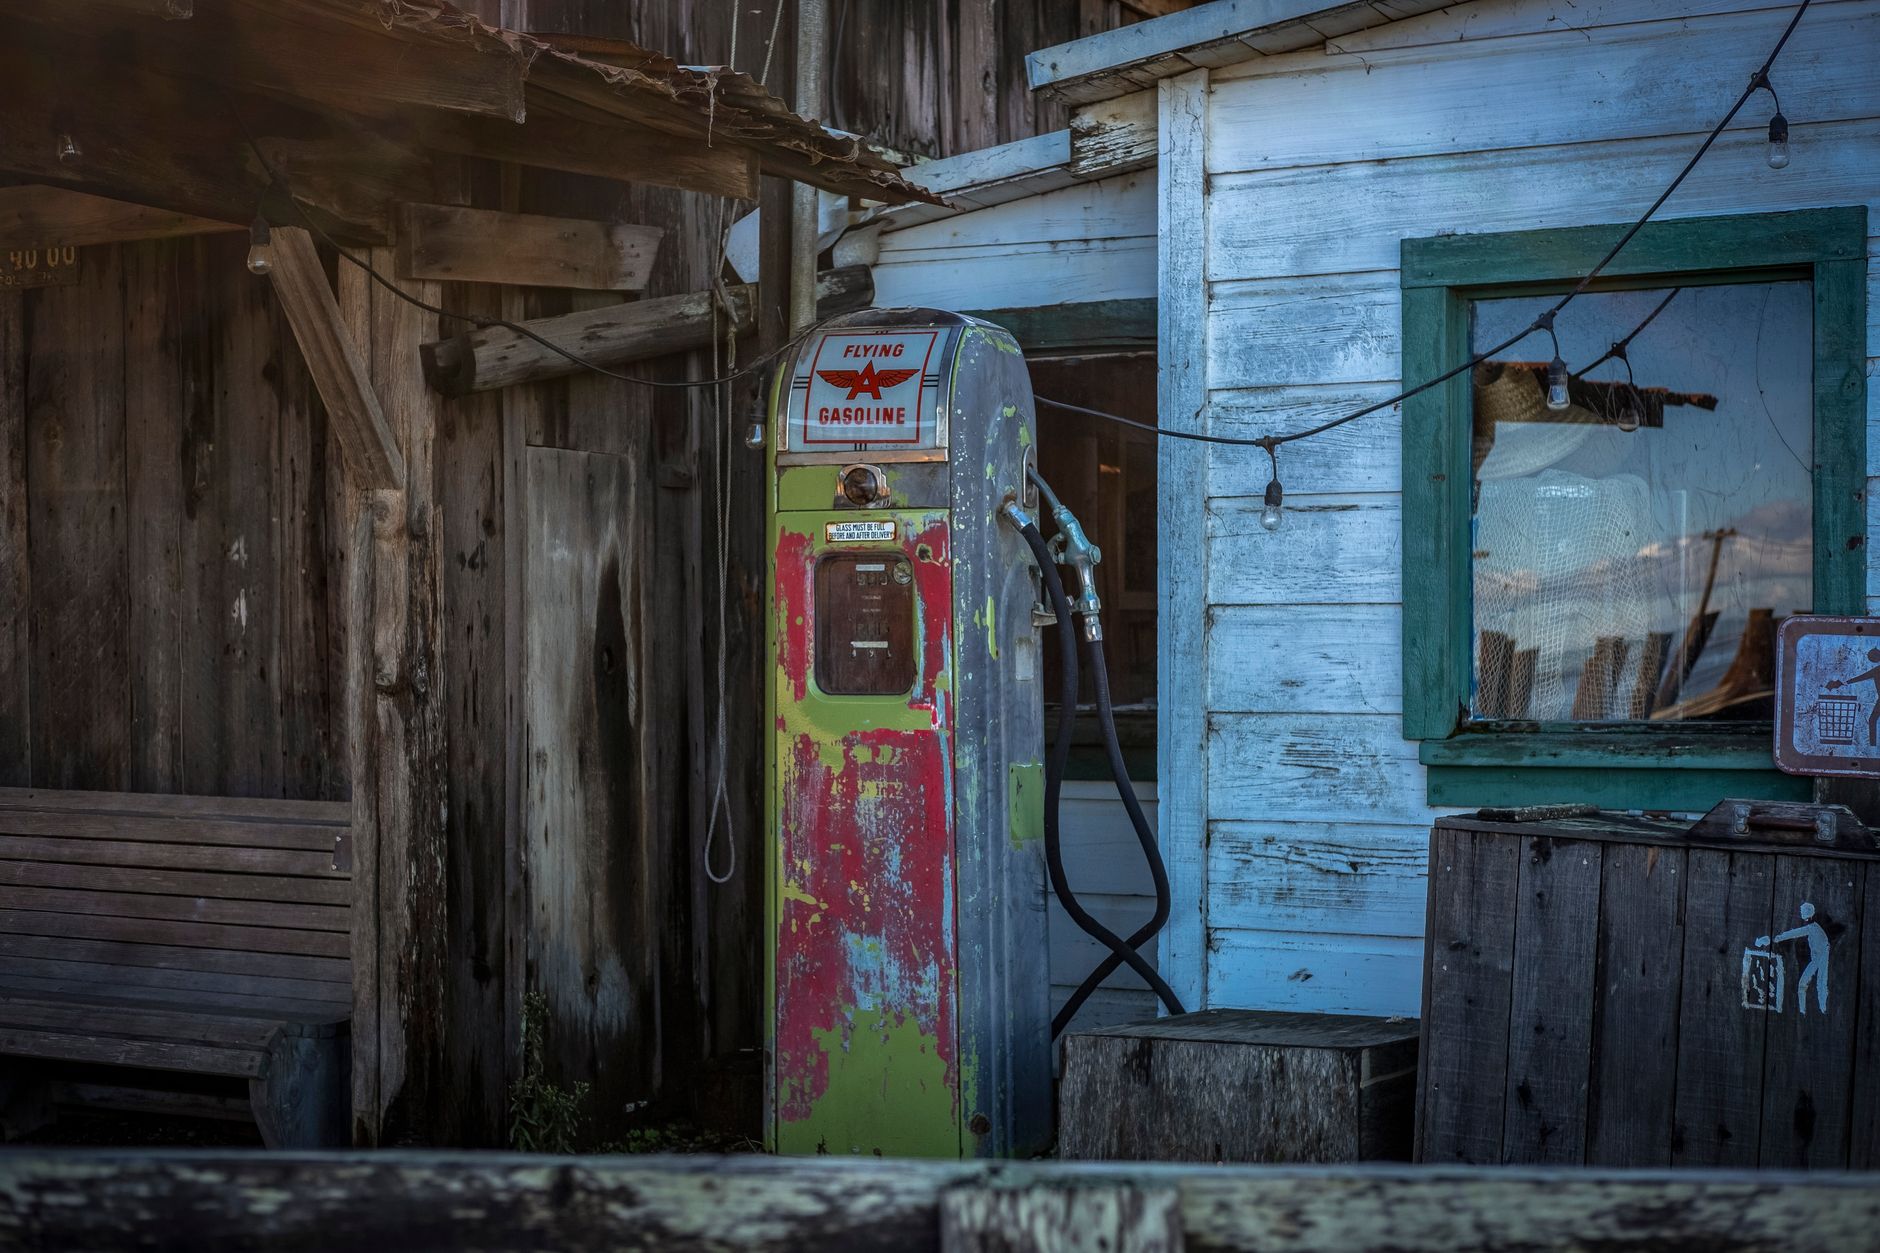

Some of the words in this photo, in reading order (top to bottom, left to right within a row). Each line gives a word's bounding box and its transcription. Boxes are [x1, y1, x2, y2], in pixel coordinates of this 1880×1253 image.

[843, 343, 905, 358] FLYING
[819, 407, 906, 425] GASOLINE
[853, 523, 866, 531] MUST
[867, 523, 873, 531] BE
[829, 532, 845, 540] BEFORE
[871, 531, 893, 539] DELIVERY
